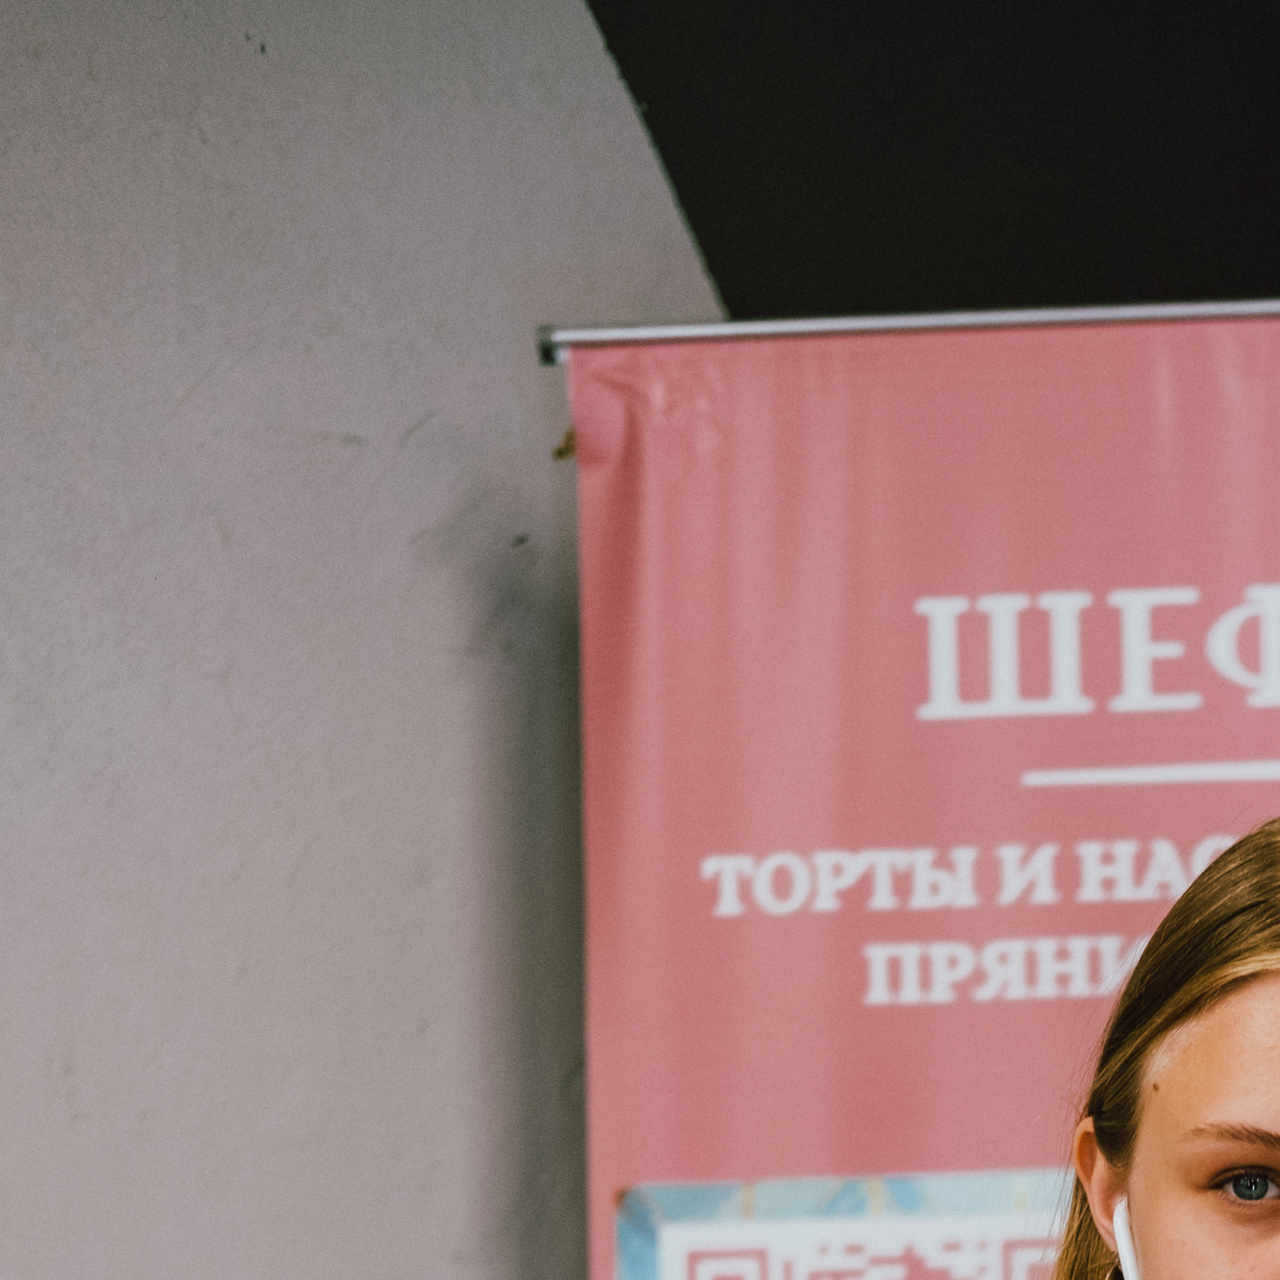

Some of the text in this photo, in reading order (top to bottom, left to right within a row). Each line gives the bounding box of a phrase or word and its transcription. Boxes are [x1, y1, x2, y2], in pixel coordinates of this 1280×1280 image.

[702, 845, 979, 917] ТОРТЫ
[994, 843, 1060, 905] И
[862, 934, 1151, 1005] ПРЯНИ
